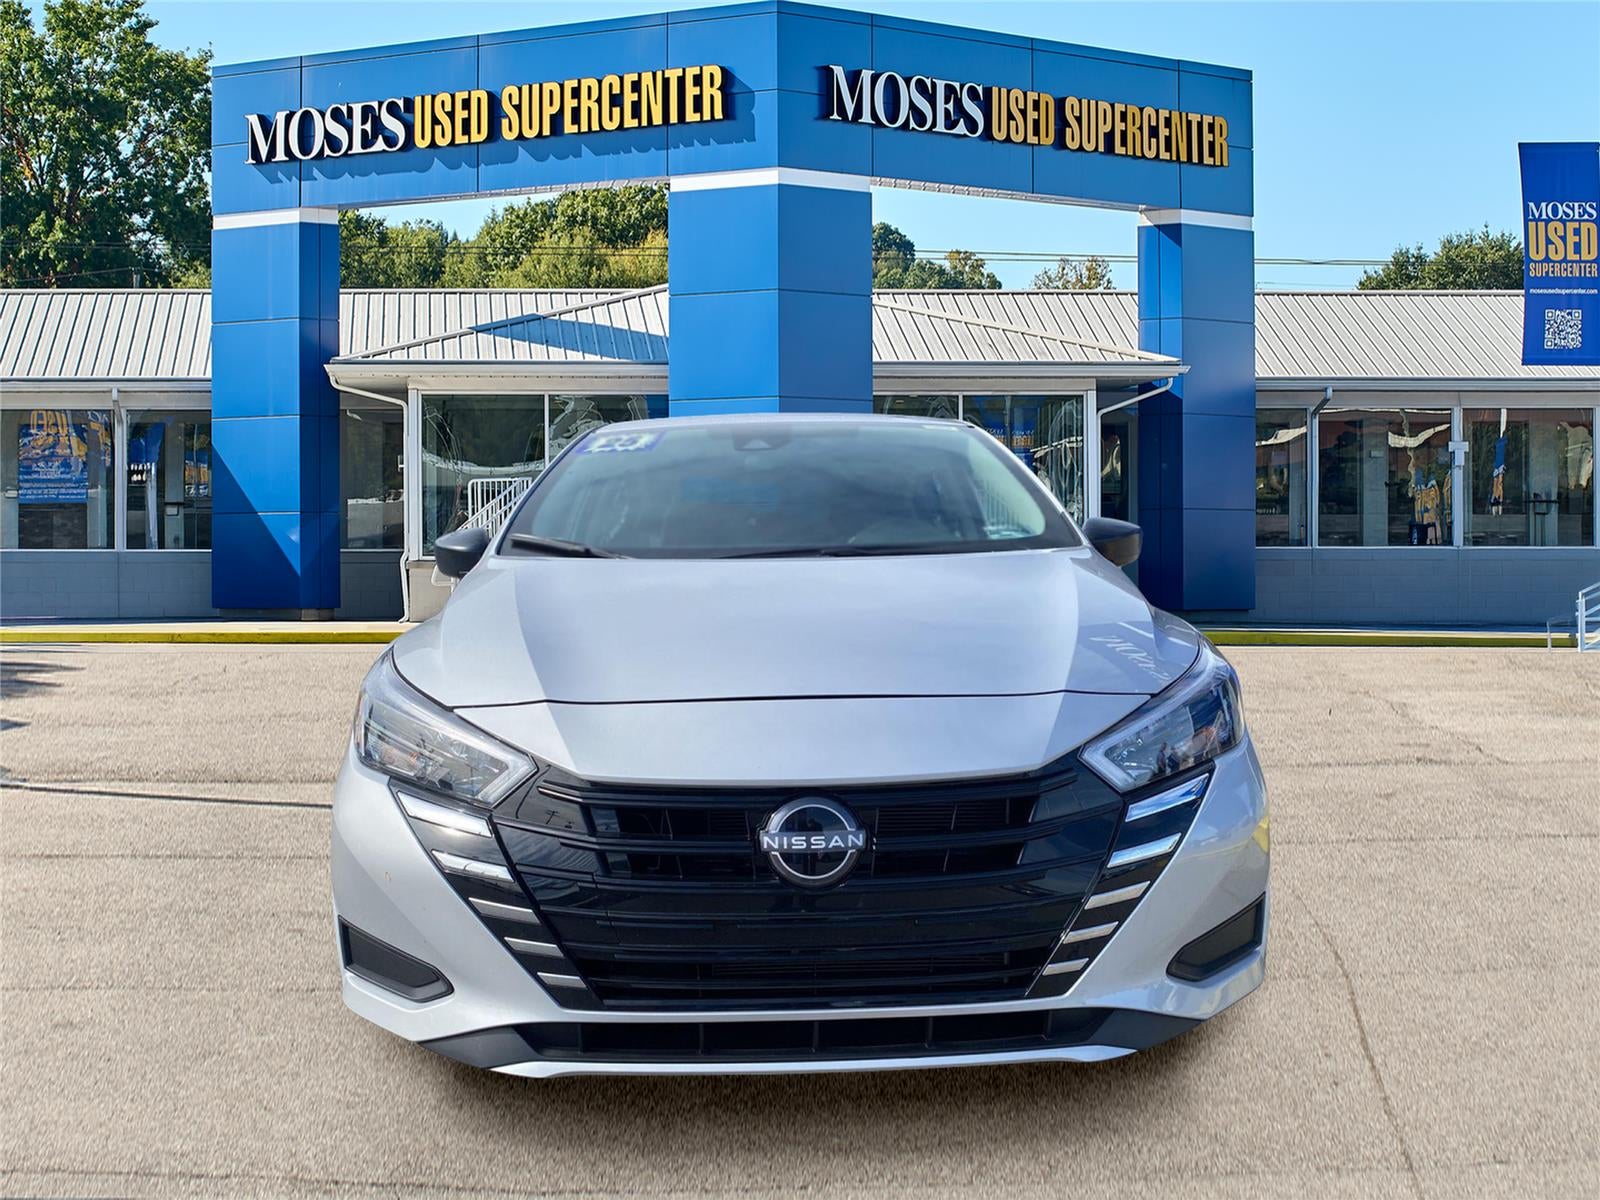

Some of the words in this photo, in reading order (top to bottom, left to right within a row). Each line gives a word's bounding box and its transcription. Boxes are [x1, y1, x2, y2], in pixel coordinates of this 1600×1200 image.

[244, 97, 406, 165] MOSES
[413, 89, 489, 149] USED
[501, 64, 724, 141] SUPERCENTER
[829, 64, 985, 138] MOSES
[991, 86, 1056, 146] USED
[1065, 96, 1229, 168] SUPERCENTER
[1527, 201, 1598, 220] MOSES
[1528, 221, 1598, 261] USED
[1529, 262, 1598, 278] SUPERCENTER
[763, 834, 863, 849] NISSAN
